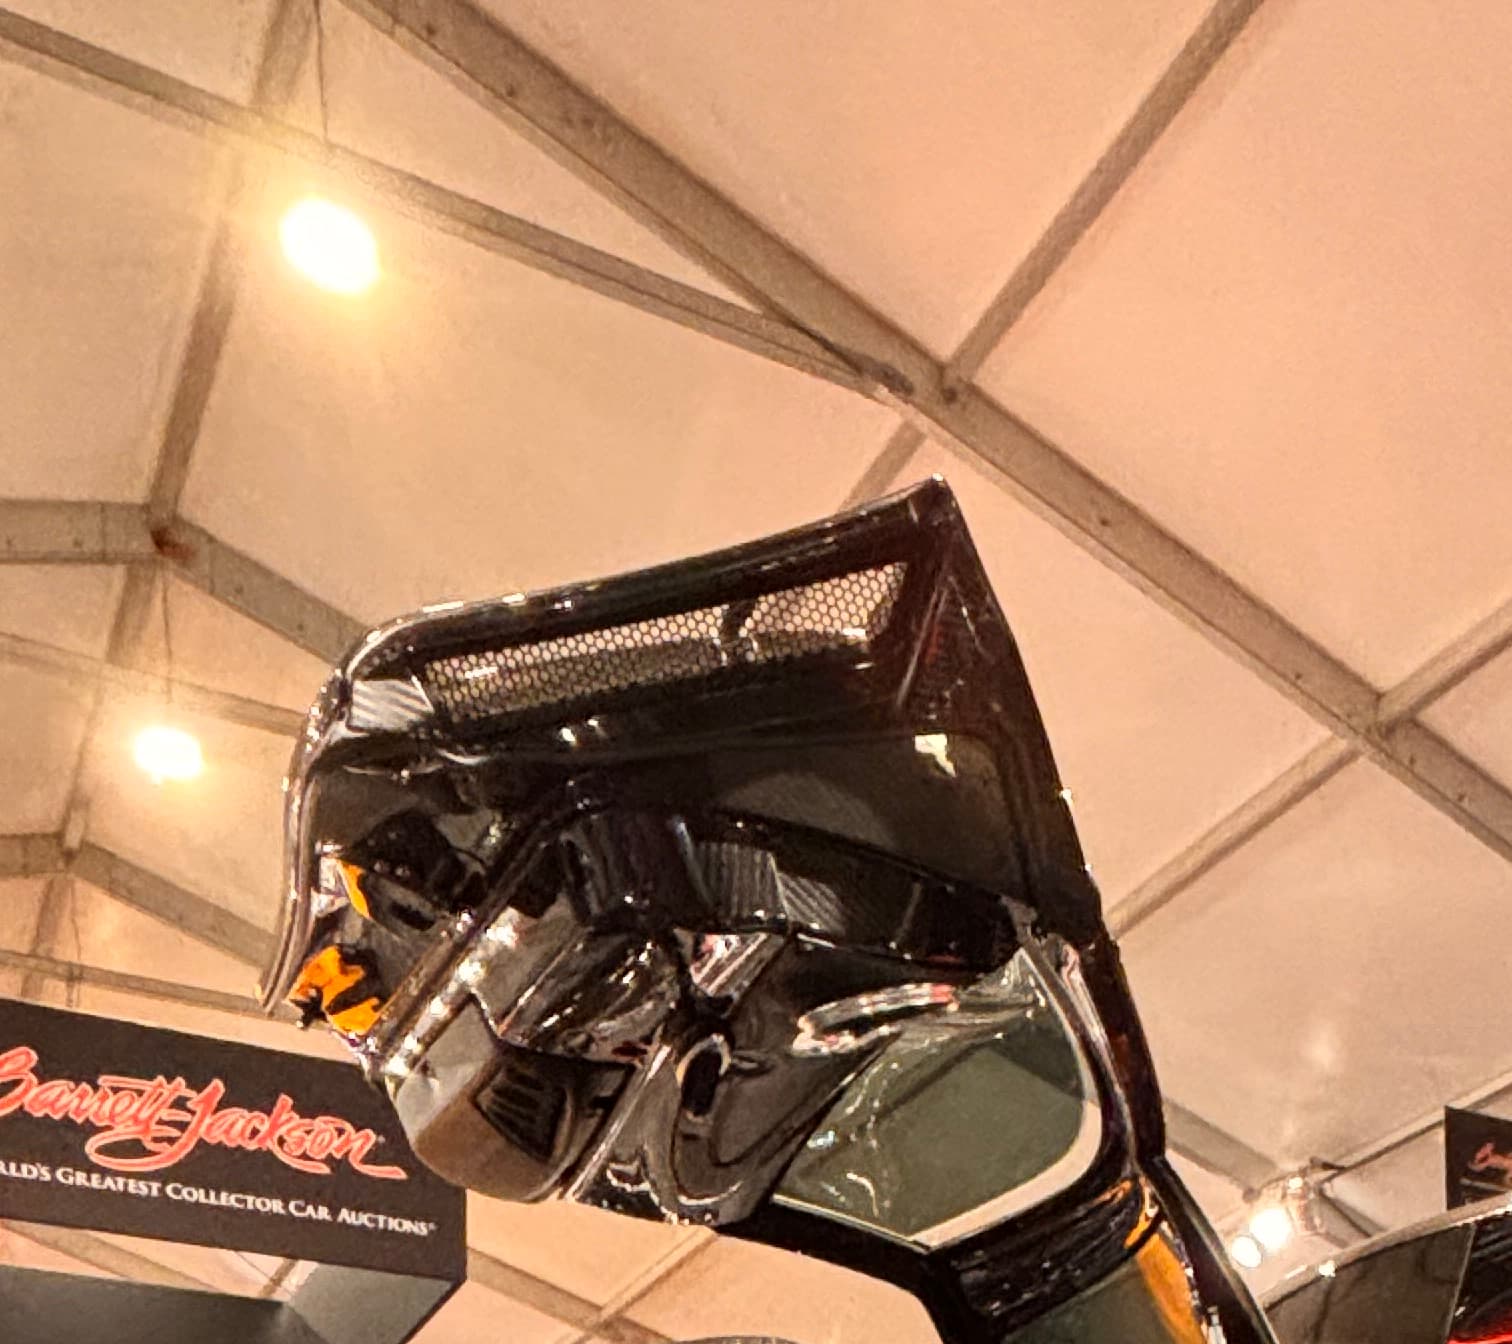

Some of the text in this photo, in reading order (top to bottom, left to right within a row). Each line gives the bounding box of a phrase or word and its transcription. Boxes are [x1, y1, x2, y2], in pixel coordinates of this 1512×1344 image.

[55, 1166, 162, 1198] GREATEST
[165, 1181, 286, 1216] COLLECTOR
[288, 1199, 334, 1222] CAR
